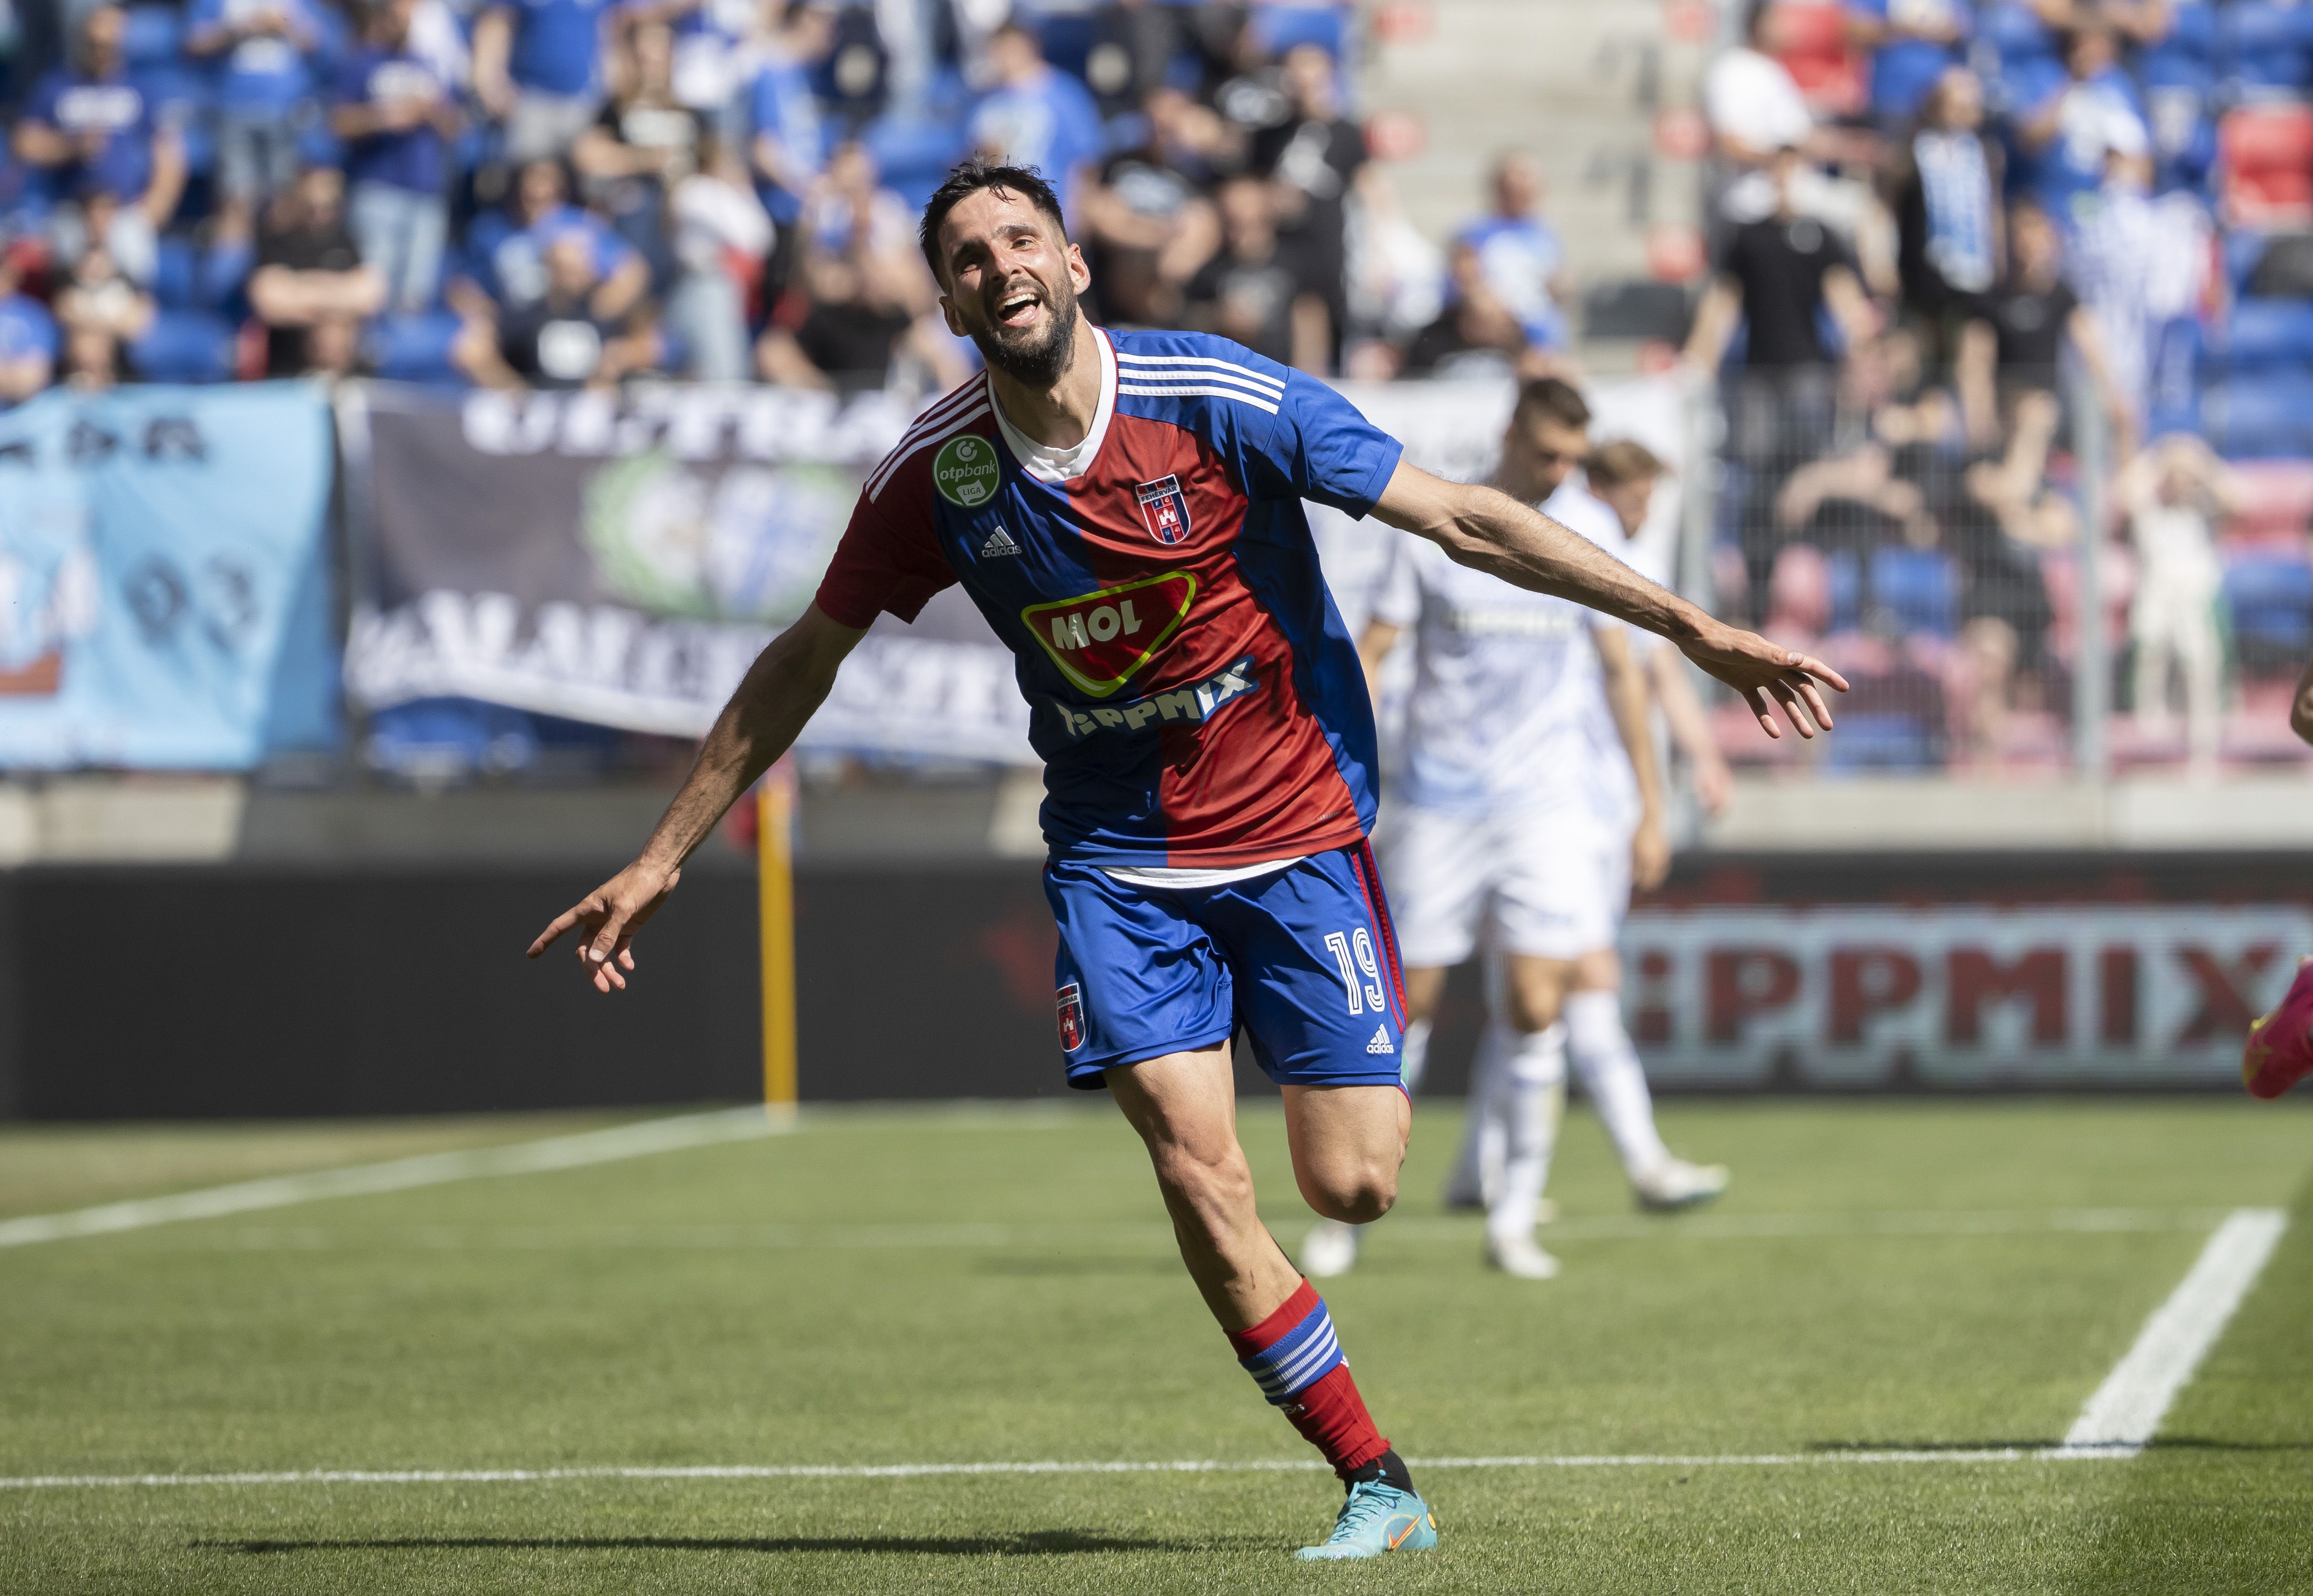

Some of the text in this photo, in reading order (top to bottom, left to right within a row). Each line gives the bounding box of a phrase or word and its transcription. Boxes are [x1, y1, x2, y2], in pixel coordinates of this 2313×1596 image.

[940, 460, 995, 482] otpbank
[963, 487, 981, 495] LIGA
[1141, 485, 1177, 502] FEHÉRVÁR
[982, 545, 1022, 557] adidas
[1051, 600, 1143, 650] MOL
[1324, 927, 1385, 1015] 19
[1366, 1043, 1394, 1054] adidas
